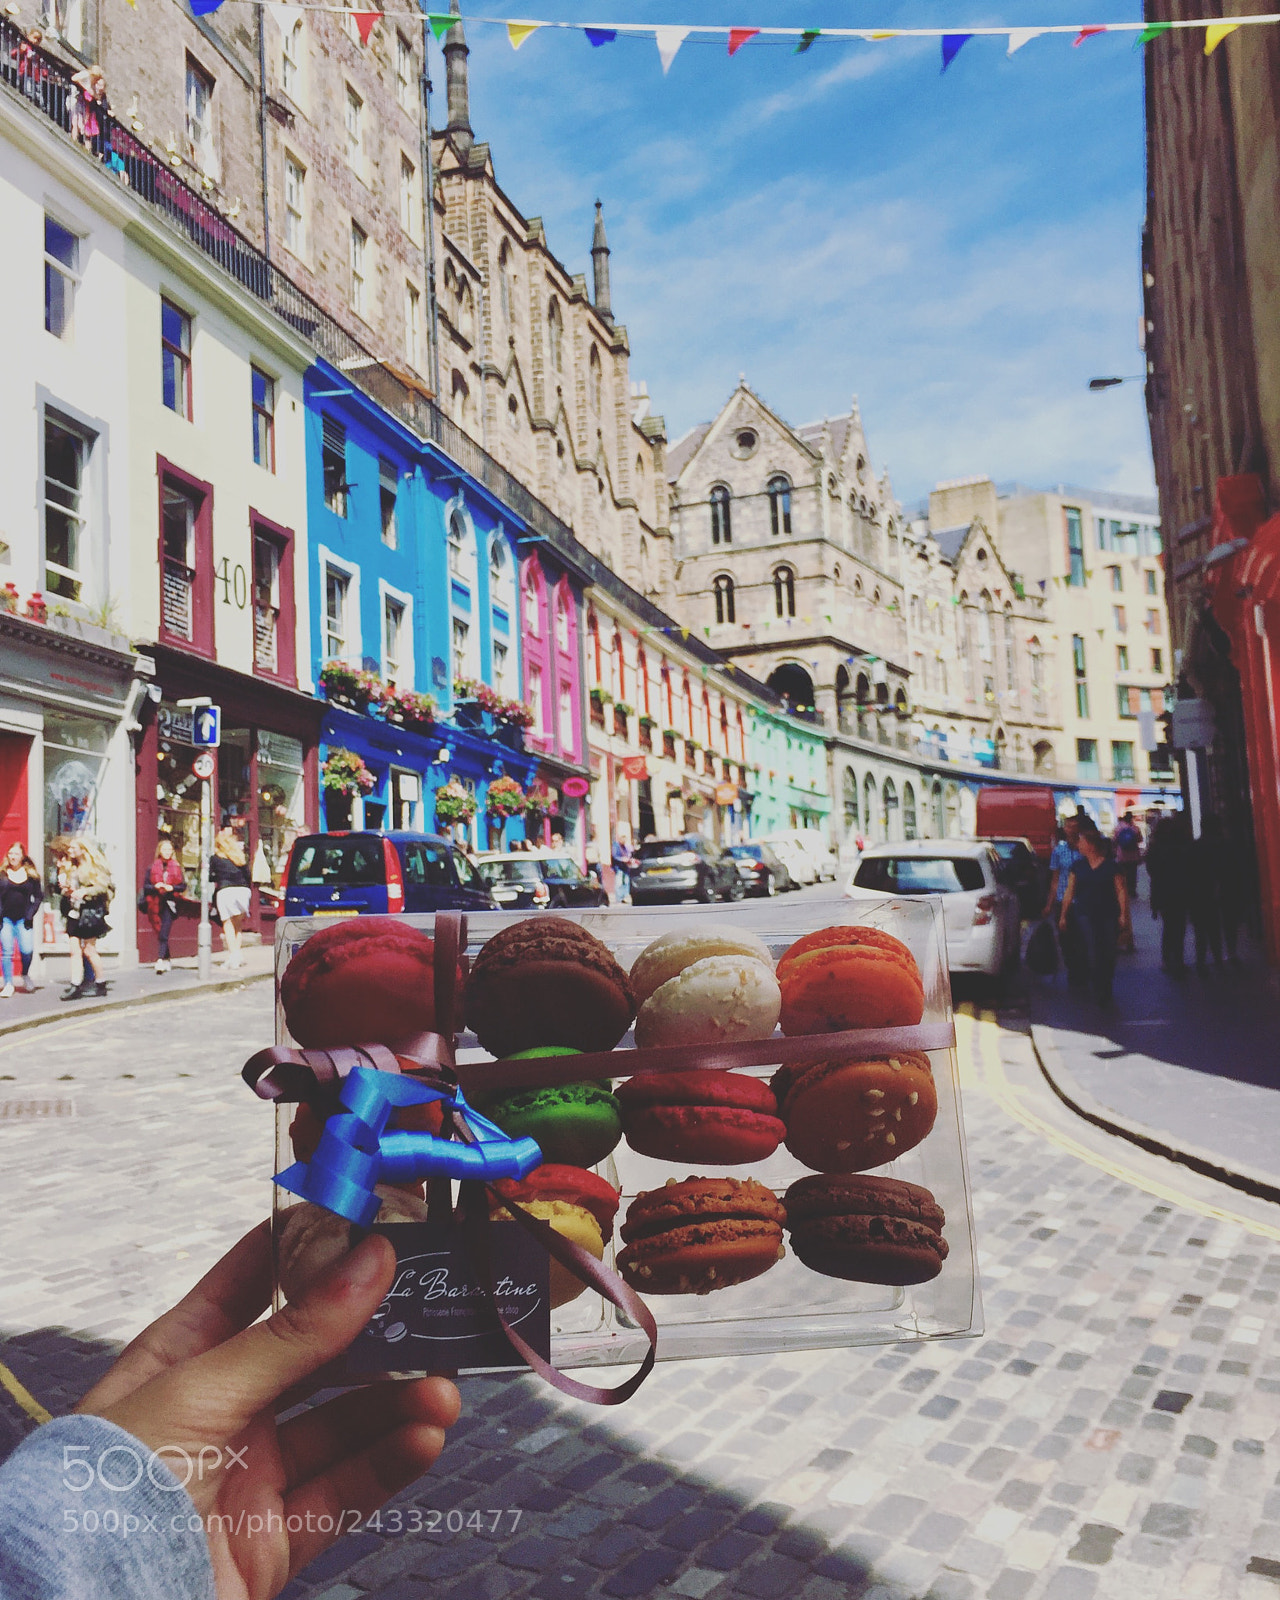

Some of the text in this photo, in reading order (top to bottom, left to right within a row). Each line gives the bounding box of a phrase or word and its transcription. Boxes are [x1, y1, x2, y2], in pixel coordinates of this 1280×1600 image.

[214, 557, 246, 610] 40
[384, 1268, 538, 1301] La Baratine
